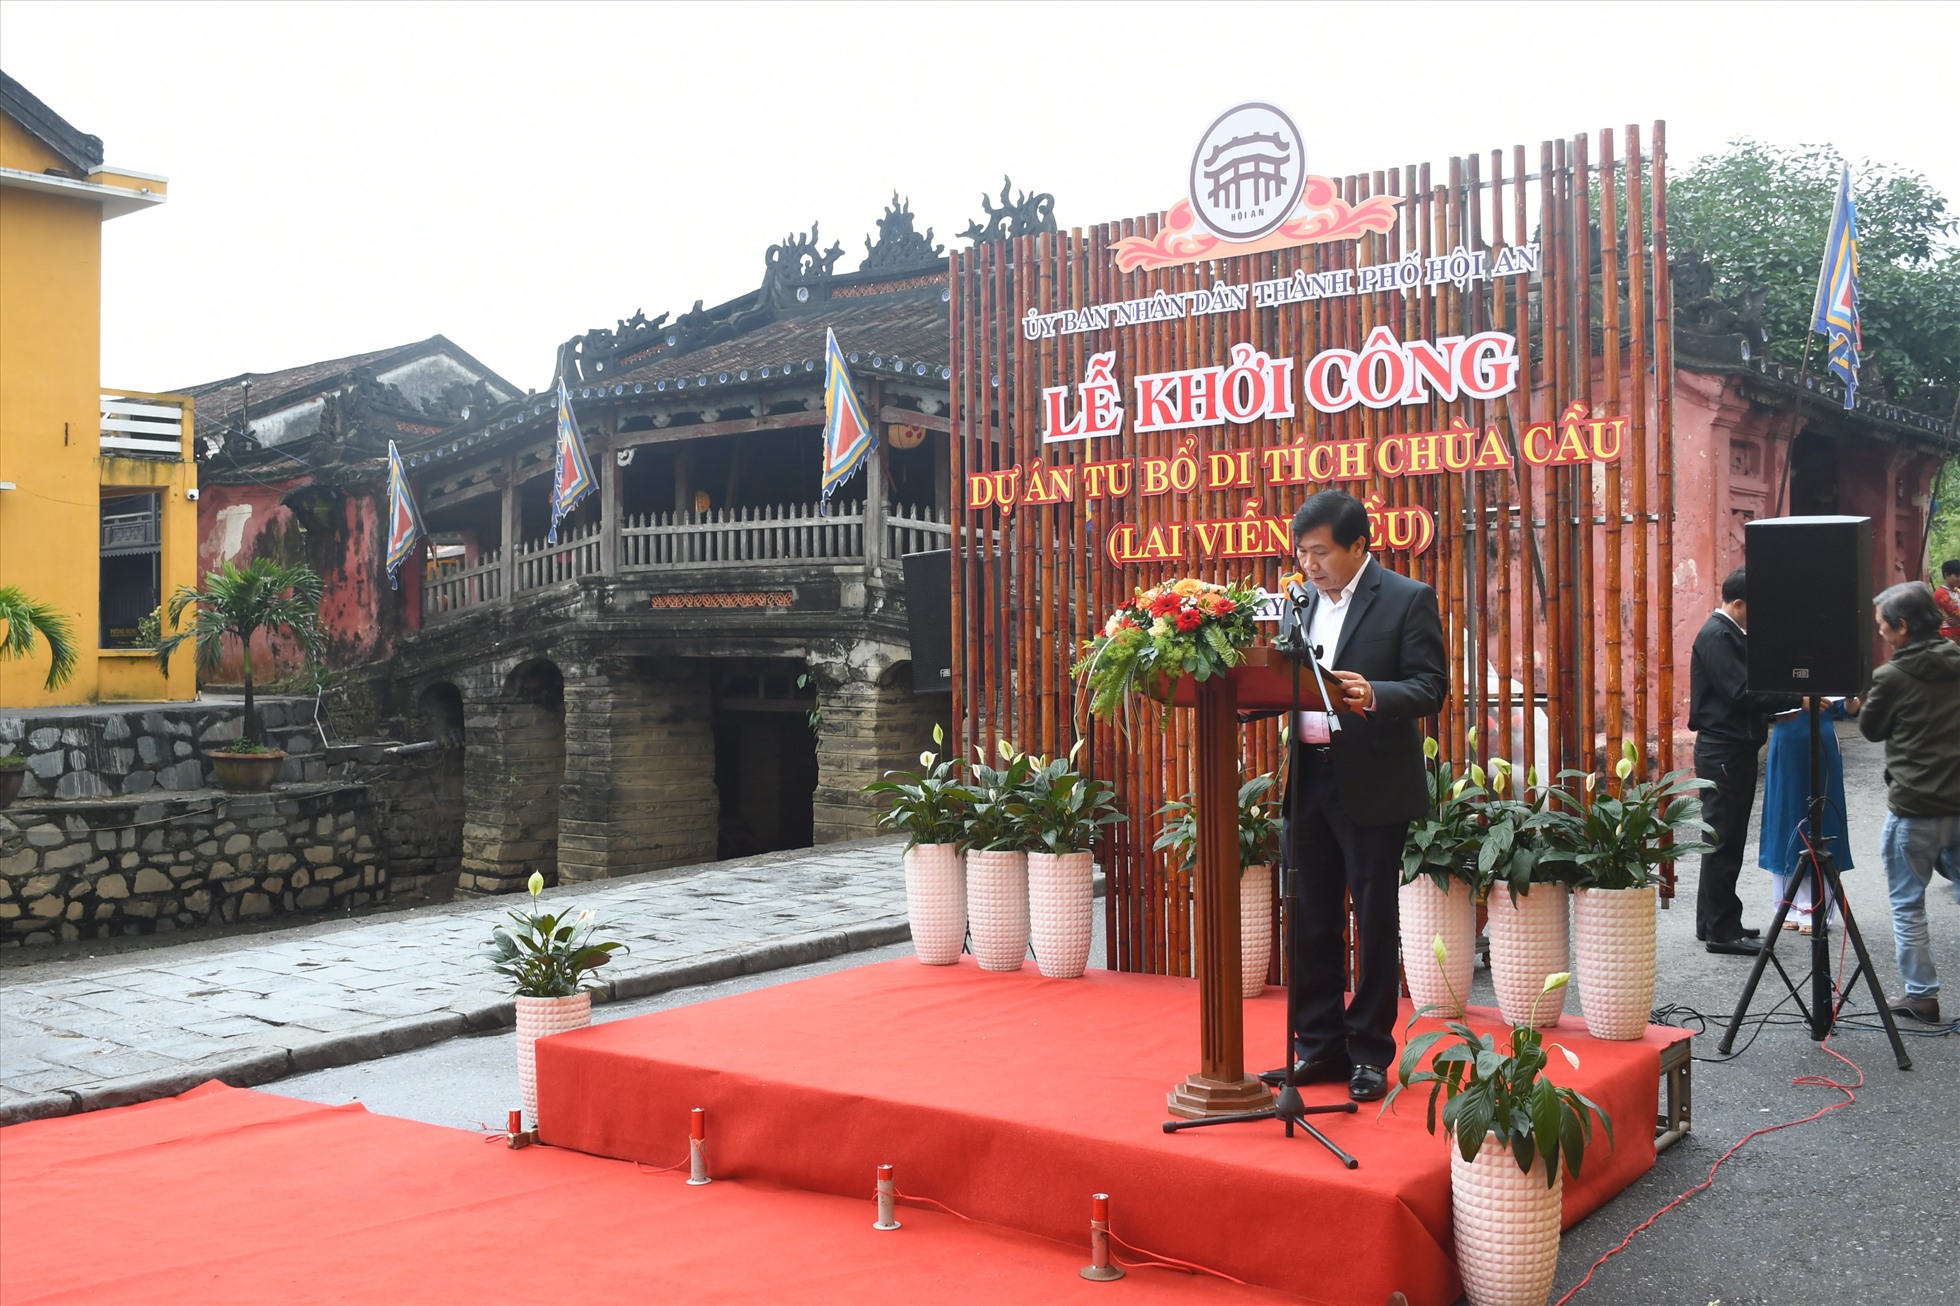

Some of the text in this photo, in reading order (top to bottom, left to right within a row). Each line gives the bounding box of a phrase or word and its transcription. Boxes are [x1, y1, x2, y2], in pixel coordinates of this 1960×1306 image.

[1251, 208, 1264, 218] AN
[1025, 246, 1539, 338] ỦY BAN NHÂN DÂN THÀNH PHỐ HỘI AN
[1047, 330, 1513, 438] LỄ KHỞI CÔNG
[969, 403, 1626, 513] DỰ ÁN TU BỔ DI TÍCH CHÙA CẦU
[1109, 524, 1184, 564] (LAI
[1194, 498, 1293, 556] VIỄN
